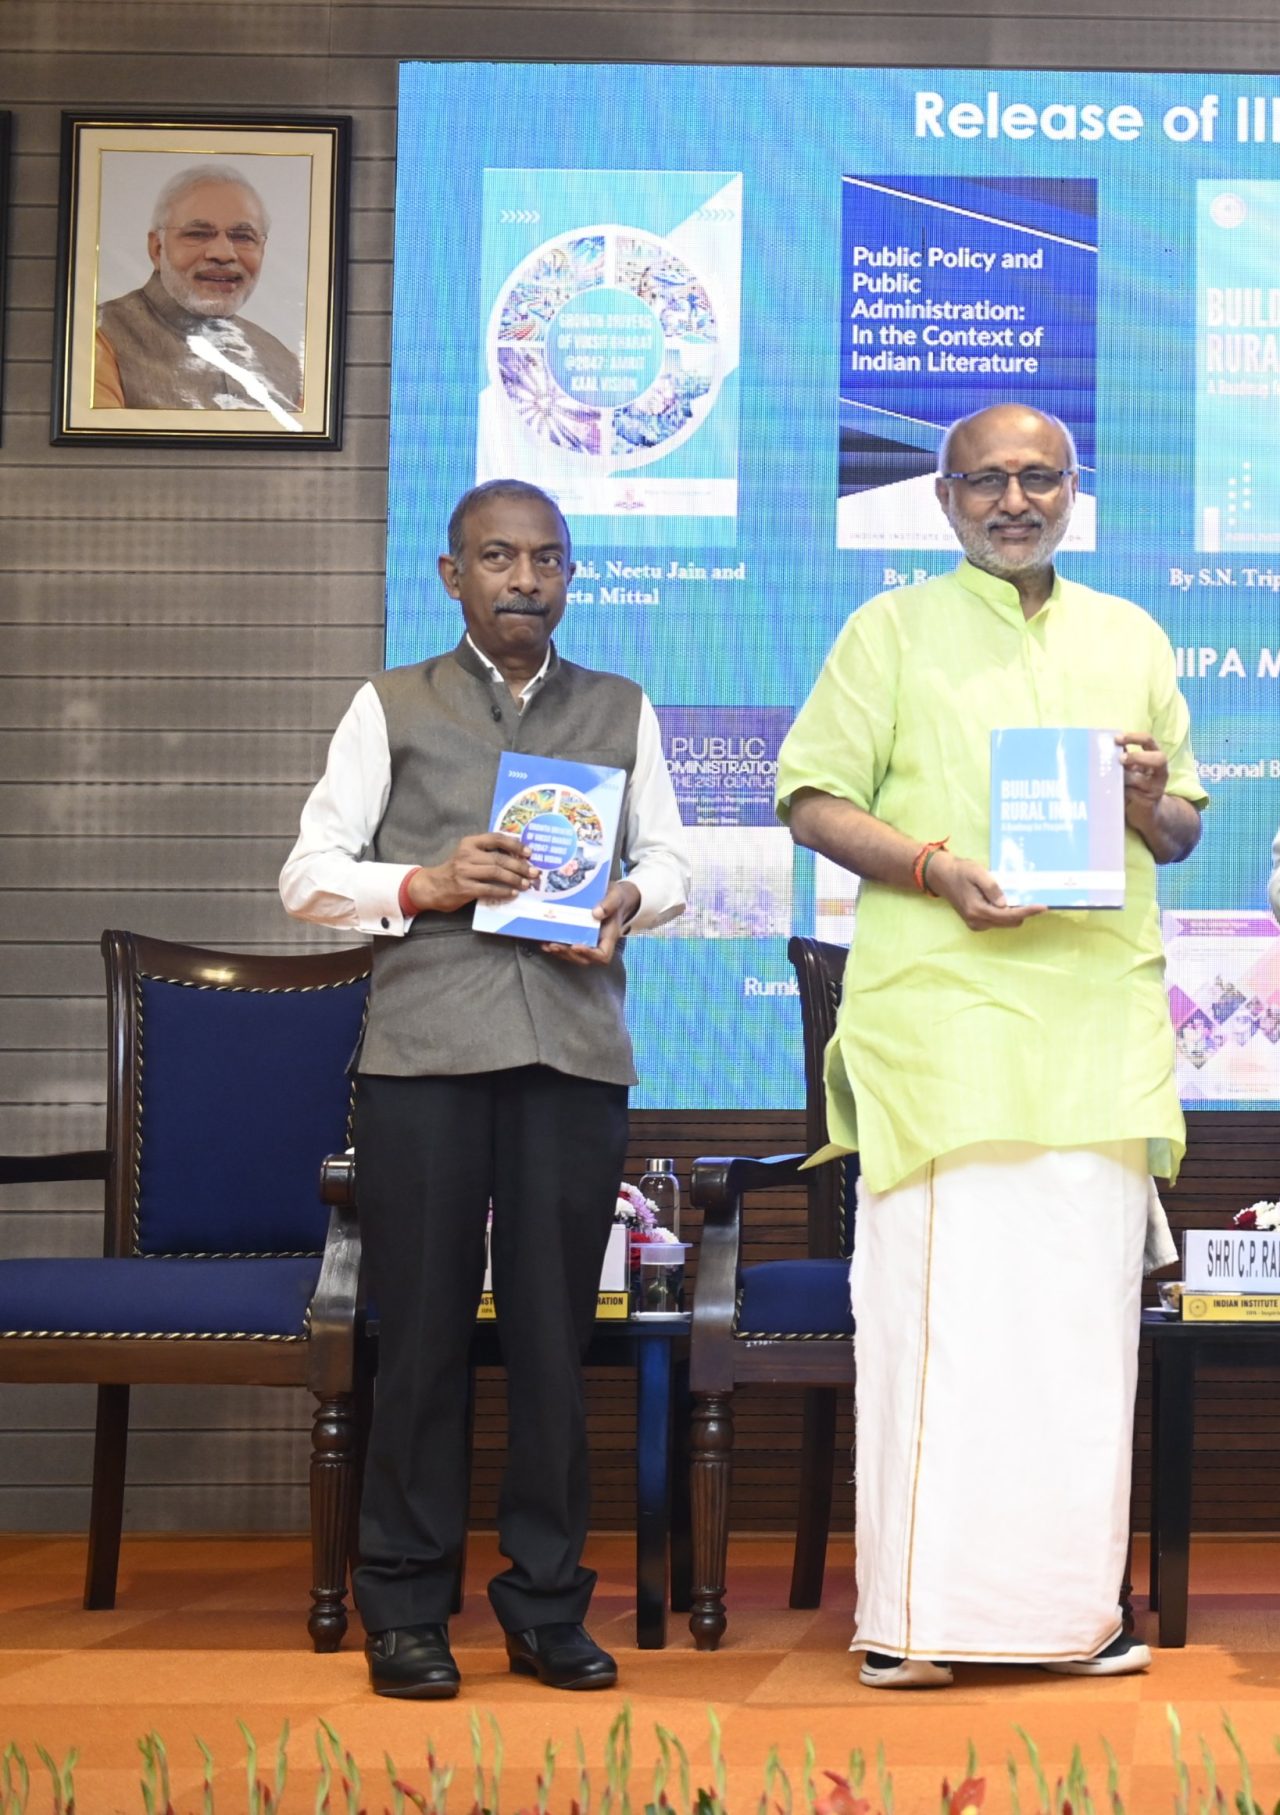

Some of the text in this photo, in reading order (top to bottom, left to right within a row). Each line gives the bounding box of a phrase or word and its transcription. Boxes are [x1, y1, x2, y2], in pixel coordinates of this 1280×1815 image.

[915, 91, 1144, 141] Release
[1163, 94, 1219, 142] of
[853, 246, 1043, 272] Public Policy and
[853, 272, 921, 293] Public
[851, 298, 1025, 320] Administration:
[852, 324, 1044, 347] In the Context of
[852, 351, 1038, 373] Indian Literature
[605, 561, 662, 579] Neetu
[666, 562, 707, 579] Jain
[712, 563, 745, 580] and
[883, 568, 907, 586] By
[1169, 568, 1193, 591] By
[1199, 568, 1237, 586] S.N.
[600, 587, 659, 604] Mittal
[1176, 648, 1247, 678] IIPA
[671, 737, 766, 760] PUBLIC
[723, 776, 777, 788] CENTUR
[1195, 760, 1264, 783] egional
[1001, 800, 1046, 821] RURAL
[744, 976, 800, 996] Rumk
[1207, 1239, 1235, 1278] SHRI
[1238, 1239, 1259, 1278] C.P.
[1213, 1299, 1238, 1308] INDIAN
[1241, 1299, 1278, 1308] INSTITUTE
